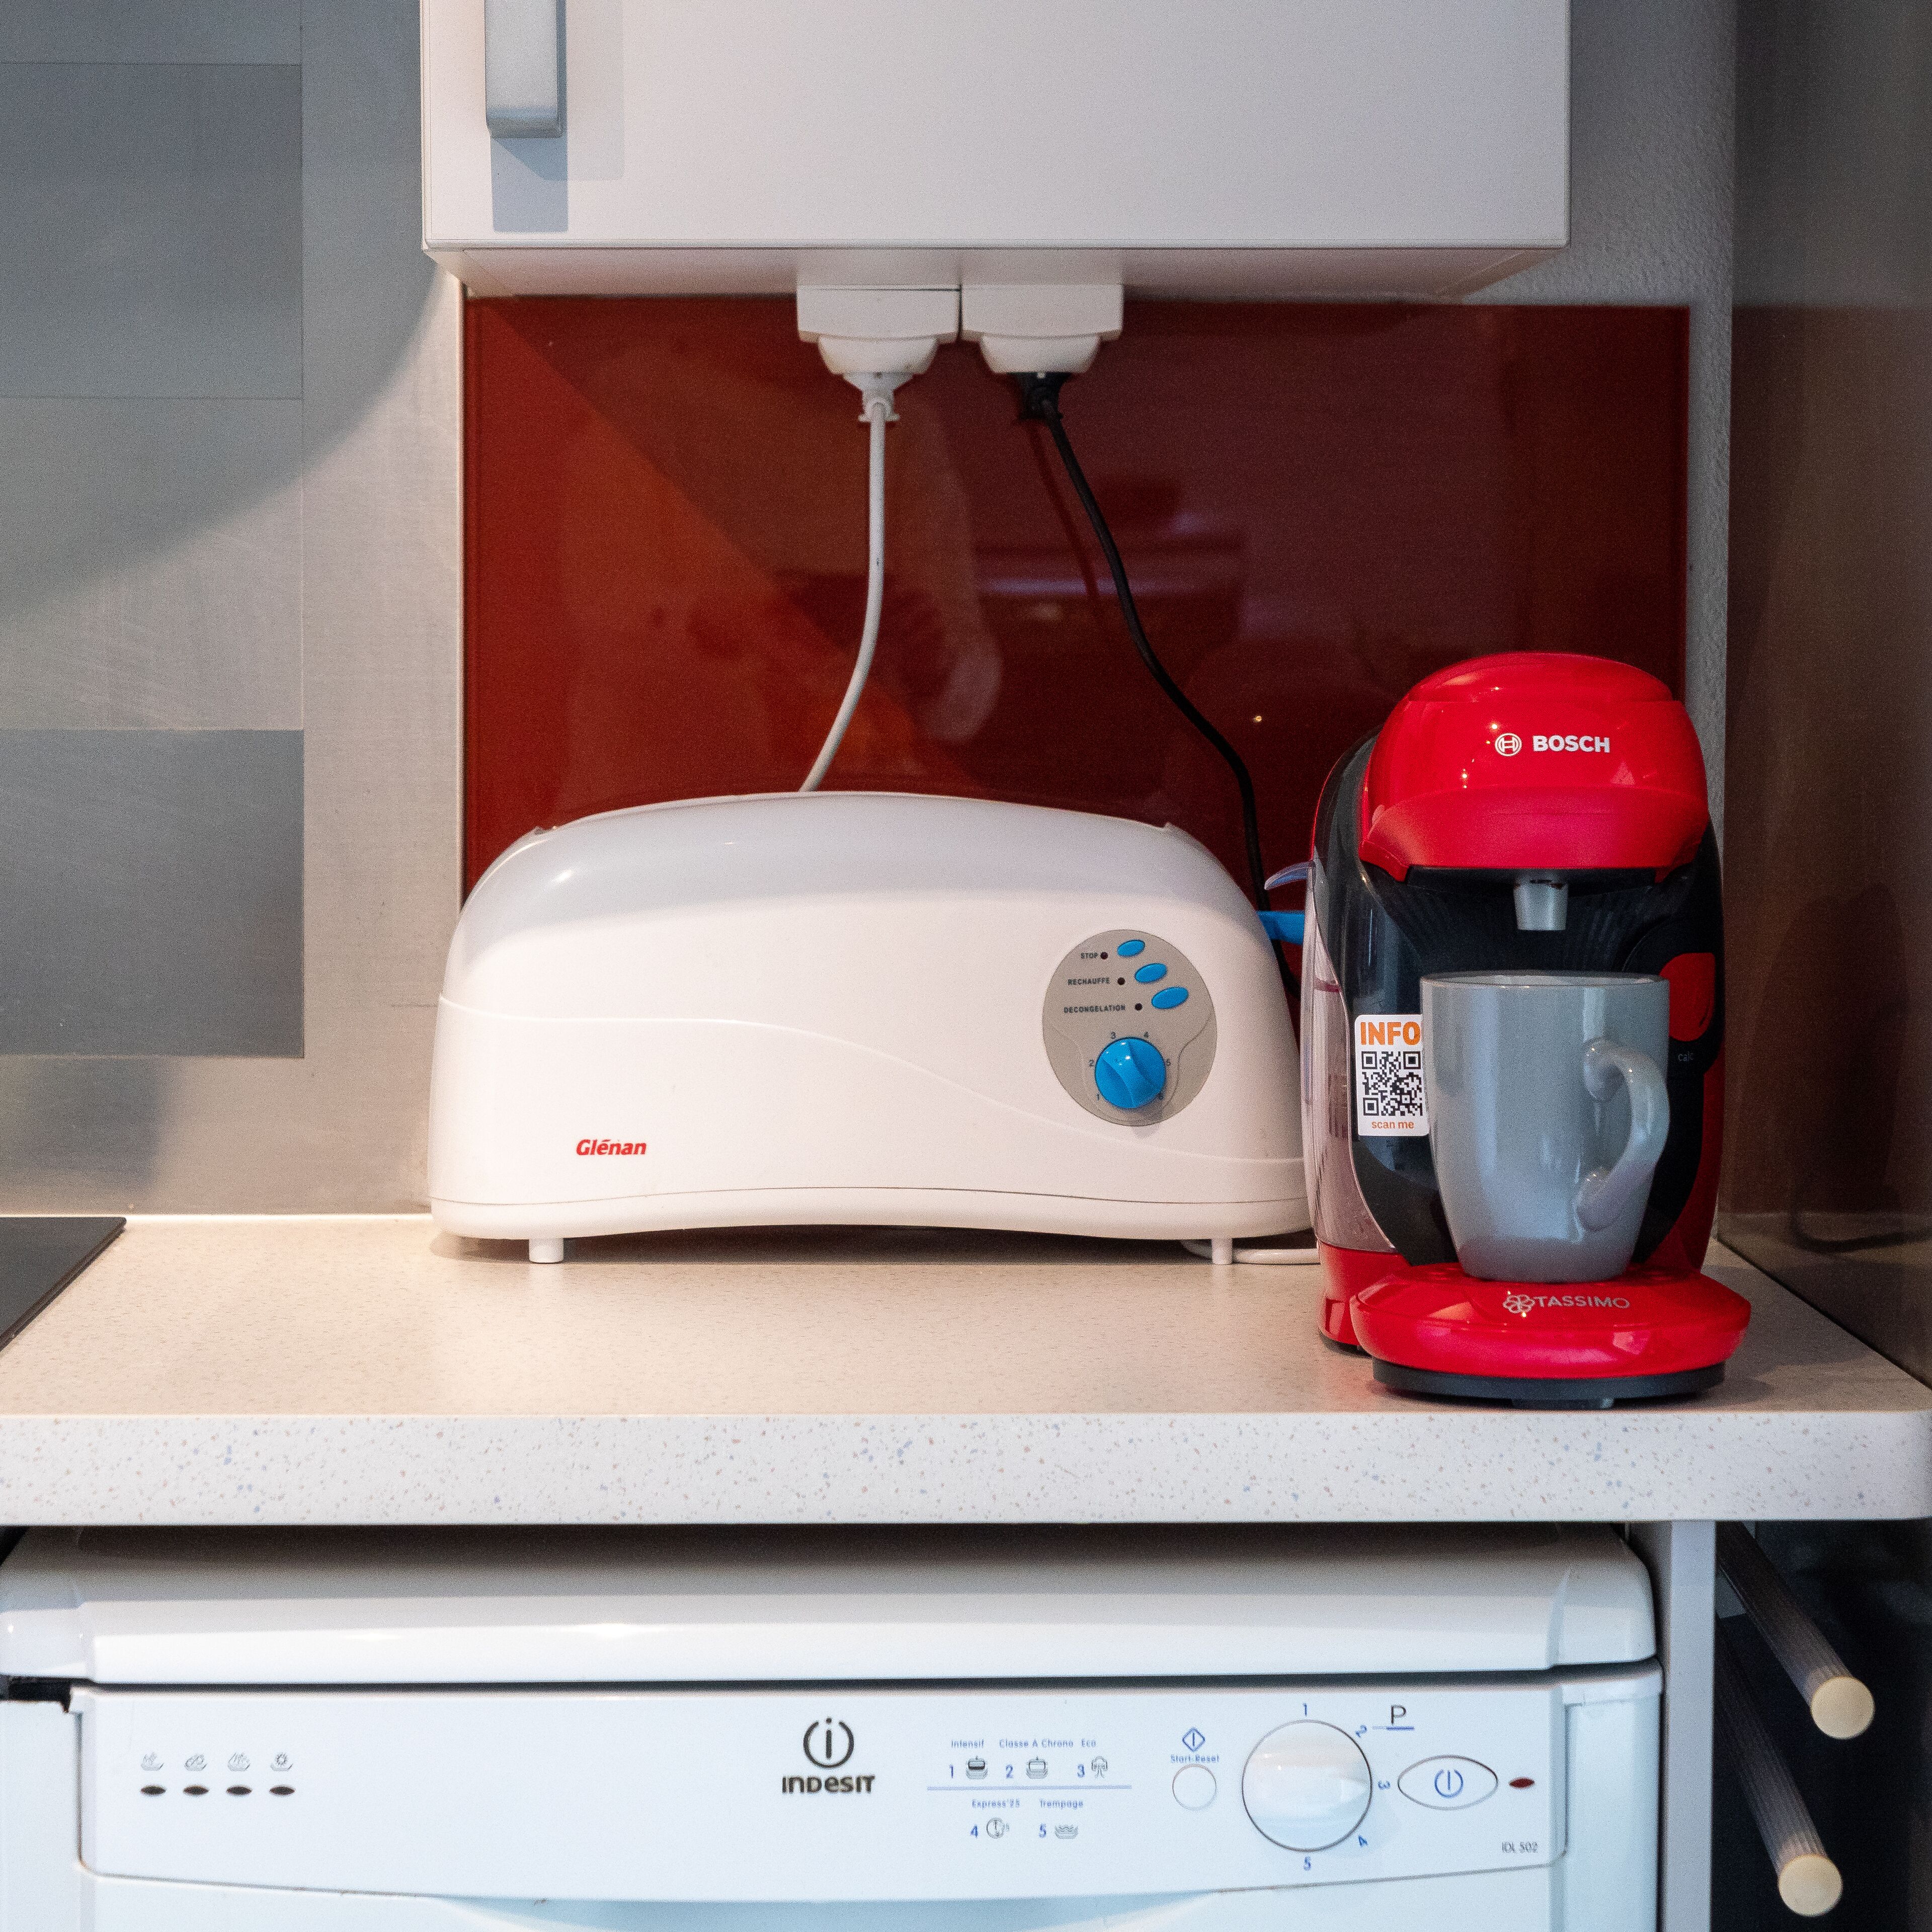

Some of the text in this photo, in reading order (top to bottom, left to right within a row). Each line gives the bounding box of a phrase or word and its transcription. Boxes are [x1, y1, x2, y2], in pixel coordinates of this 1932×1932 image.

[1533, 735, 1610, 753] BOSCH
[1068, 977, 1110, 986] RECHAUFFE
[1064, 1004, 1125, 1013] DECONGELATION
[1110, 1031, 1116, 1039] 3
[1360, 1021, 1421, 1045] INFO
[1372, 1121, 1415, 1130] scan me
[576, 1139, 647, 1156] Glénan
[1534, 1295, 1631, 1309] TASSIMO
[1303, 1703, 1308, 1717] 1
[1390, 1704, 1407, 1725] P
[950, 1739, 985, 1748] Intensif
[999, 1738, 1074, 1748] Classe A Chrono
[1082, 1738, 1096, 1748] Eco
[949, 1764, 954, 1779] 1
[1006, 1764, 1014, 1779] 2
[1077, 1763, 1085, 1778] 3
[1039, 1798, 1084, 1810] Trempage
[970, 1824, 979, 1838] 4
[1038, 1823, 1046, 1838] 5
[1304, 1856, 1312, 1871] 5
